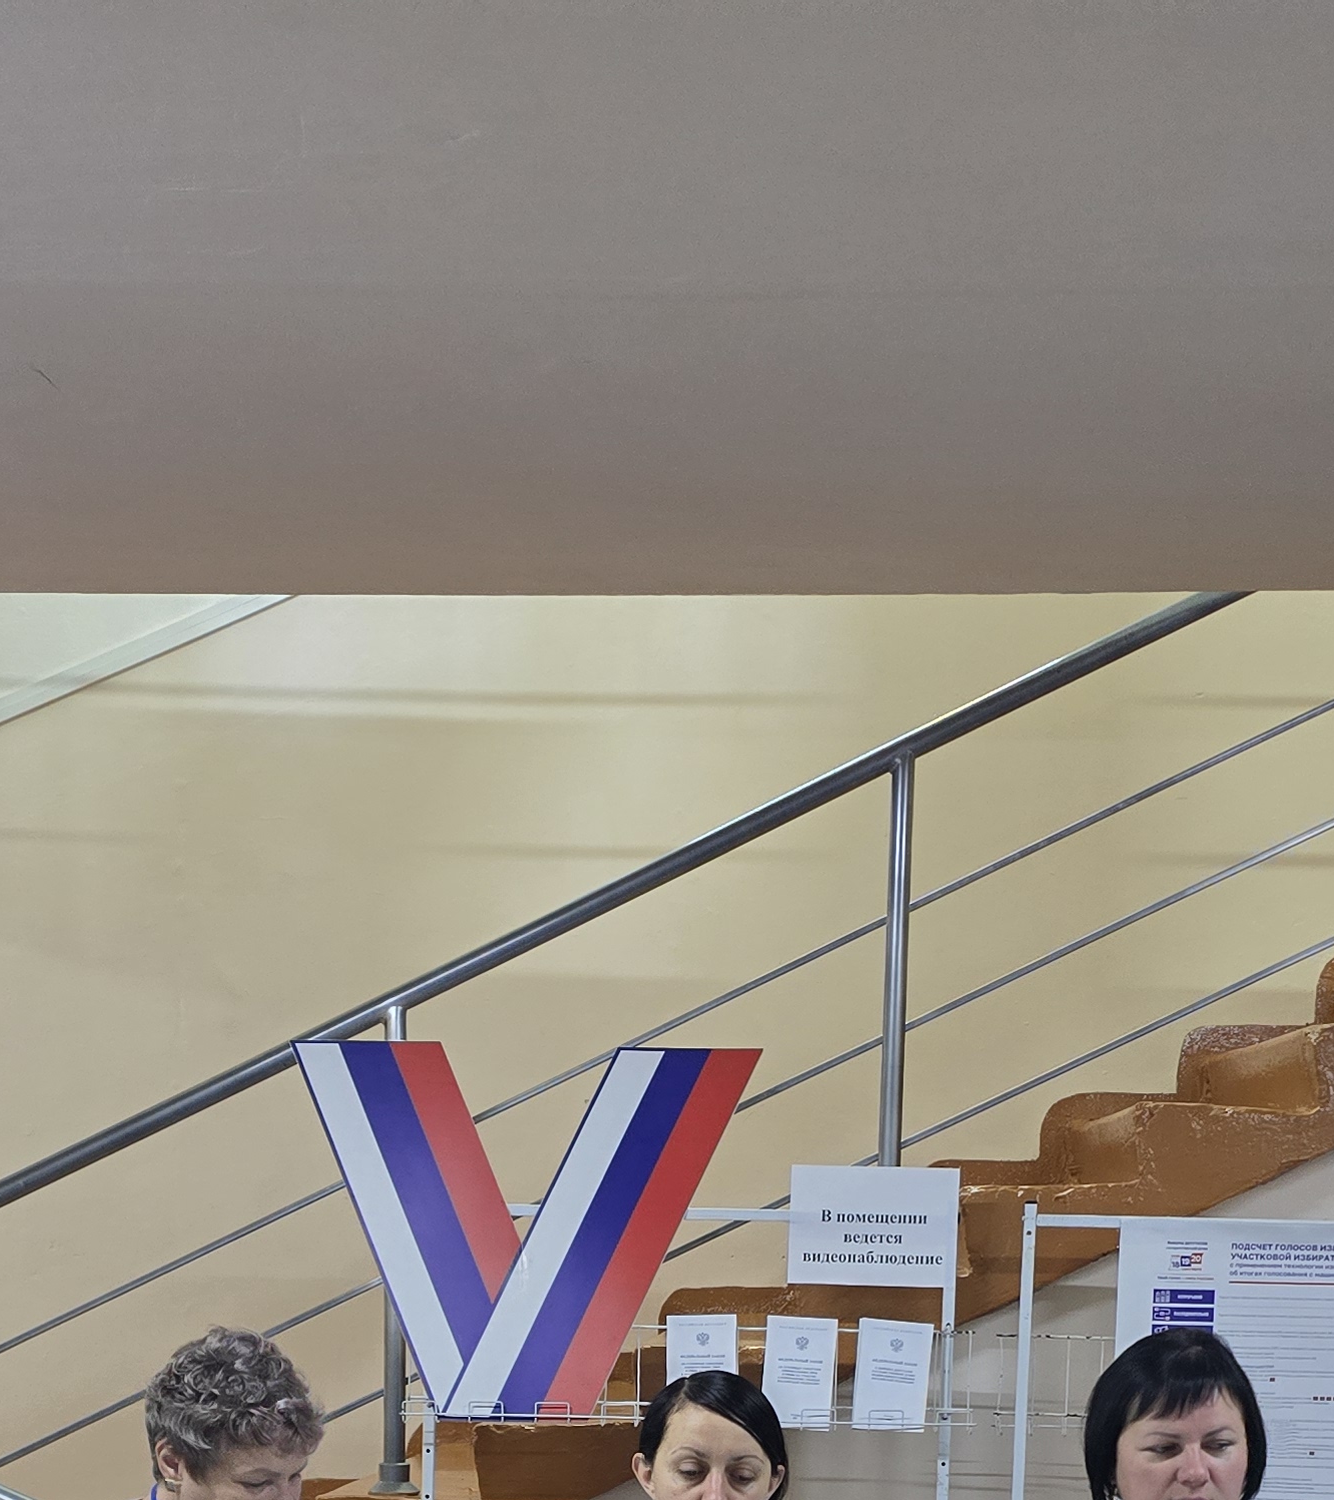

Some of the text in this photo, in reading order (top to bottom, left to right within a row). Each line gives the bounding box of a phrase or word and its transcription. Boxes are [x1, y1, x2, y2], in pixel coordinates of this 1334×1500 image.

[821, 1209, 928, 1226] В помещении
[843, 1233, 903, 1245] ведется
[1231, 1242, 1273, 1251] ПОДСЧЕТ
[1275, 1244, 1318, 1252] ГОЛОСОВ
[802, 1251, 943, 1266] видеонаблюдение
[1230, 1252, 1291, 1261] УЧАСТКОВОЙ
